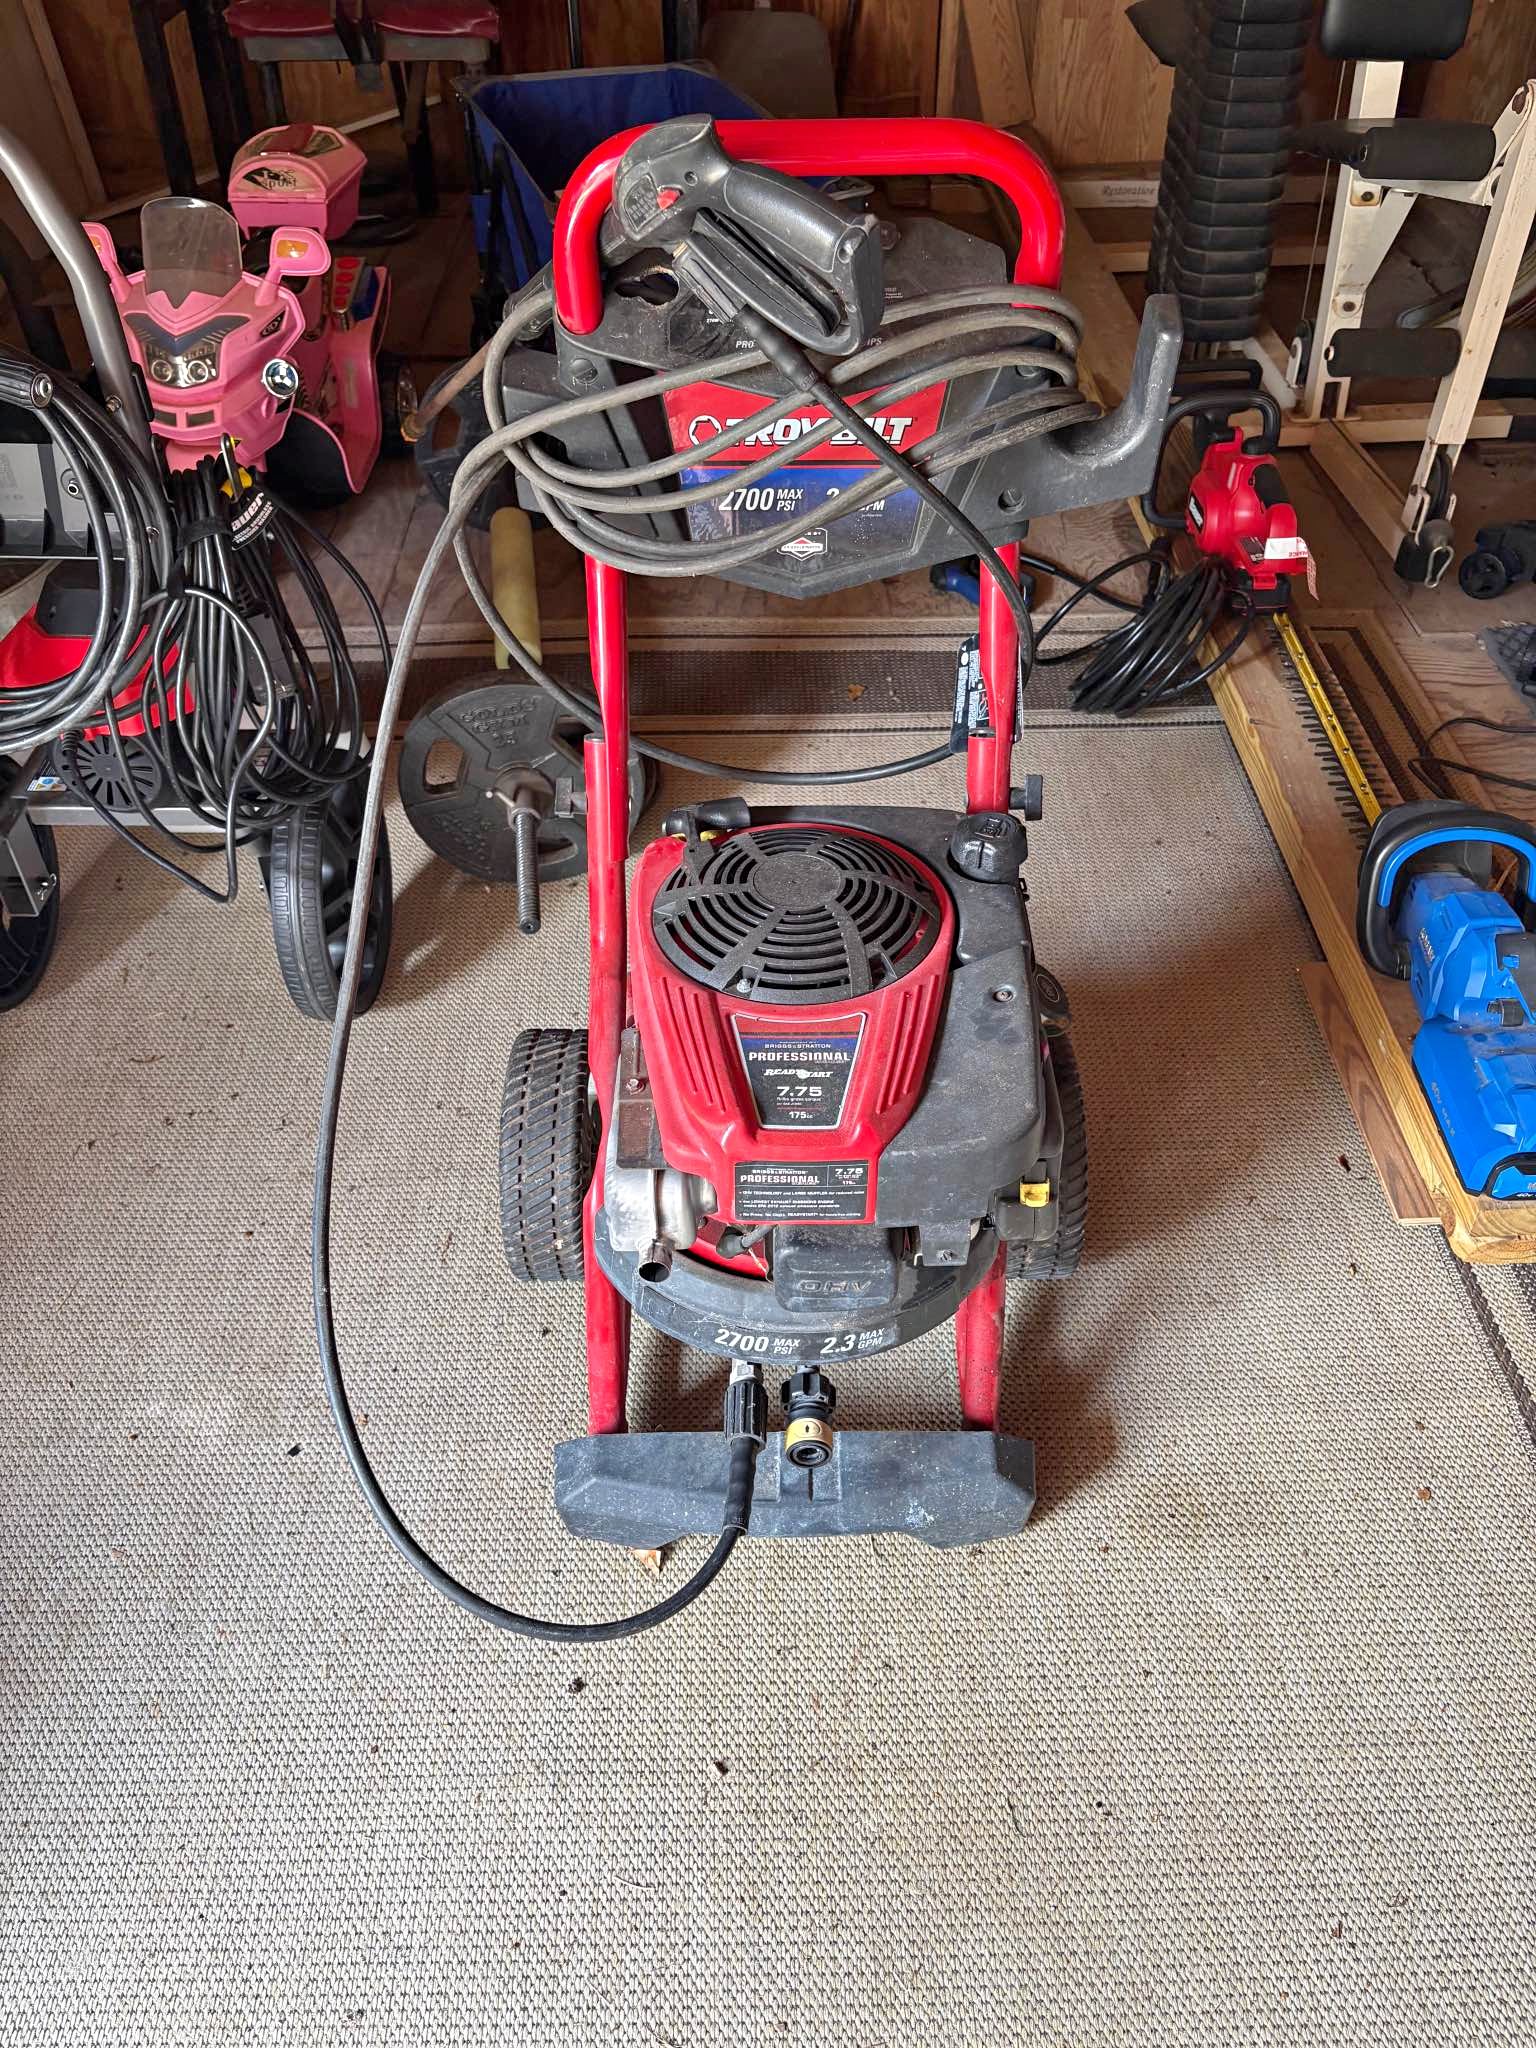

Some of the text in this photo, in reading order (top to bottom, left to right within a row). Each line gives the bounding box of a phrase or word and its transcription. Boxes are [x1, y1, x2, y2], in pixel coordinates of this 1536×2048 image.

[718, 487, 804, 511] 2700 MAX
[776, 500, 796, 511] PSI
[231, 492, 265, 532] auer
[748, 1051, 851, 1062] PROFESSIONAL
[776, 1086, 823, 1097] 7.75
[740, 1174, 820, 1184] PROFESSIONAL
[800, 1279, 871, 1291] OHV
[714, 1327, 885, 1354] 2700 MAX 2.3 MAX
[773, 1337, 883, 1355] PSI GPM
